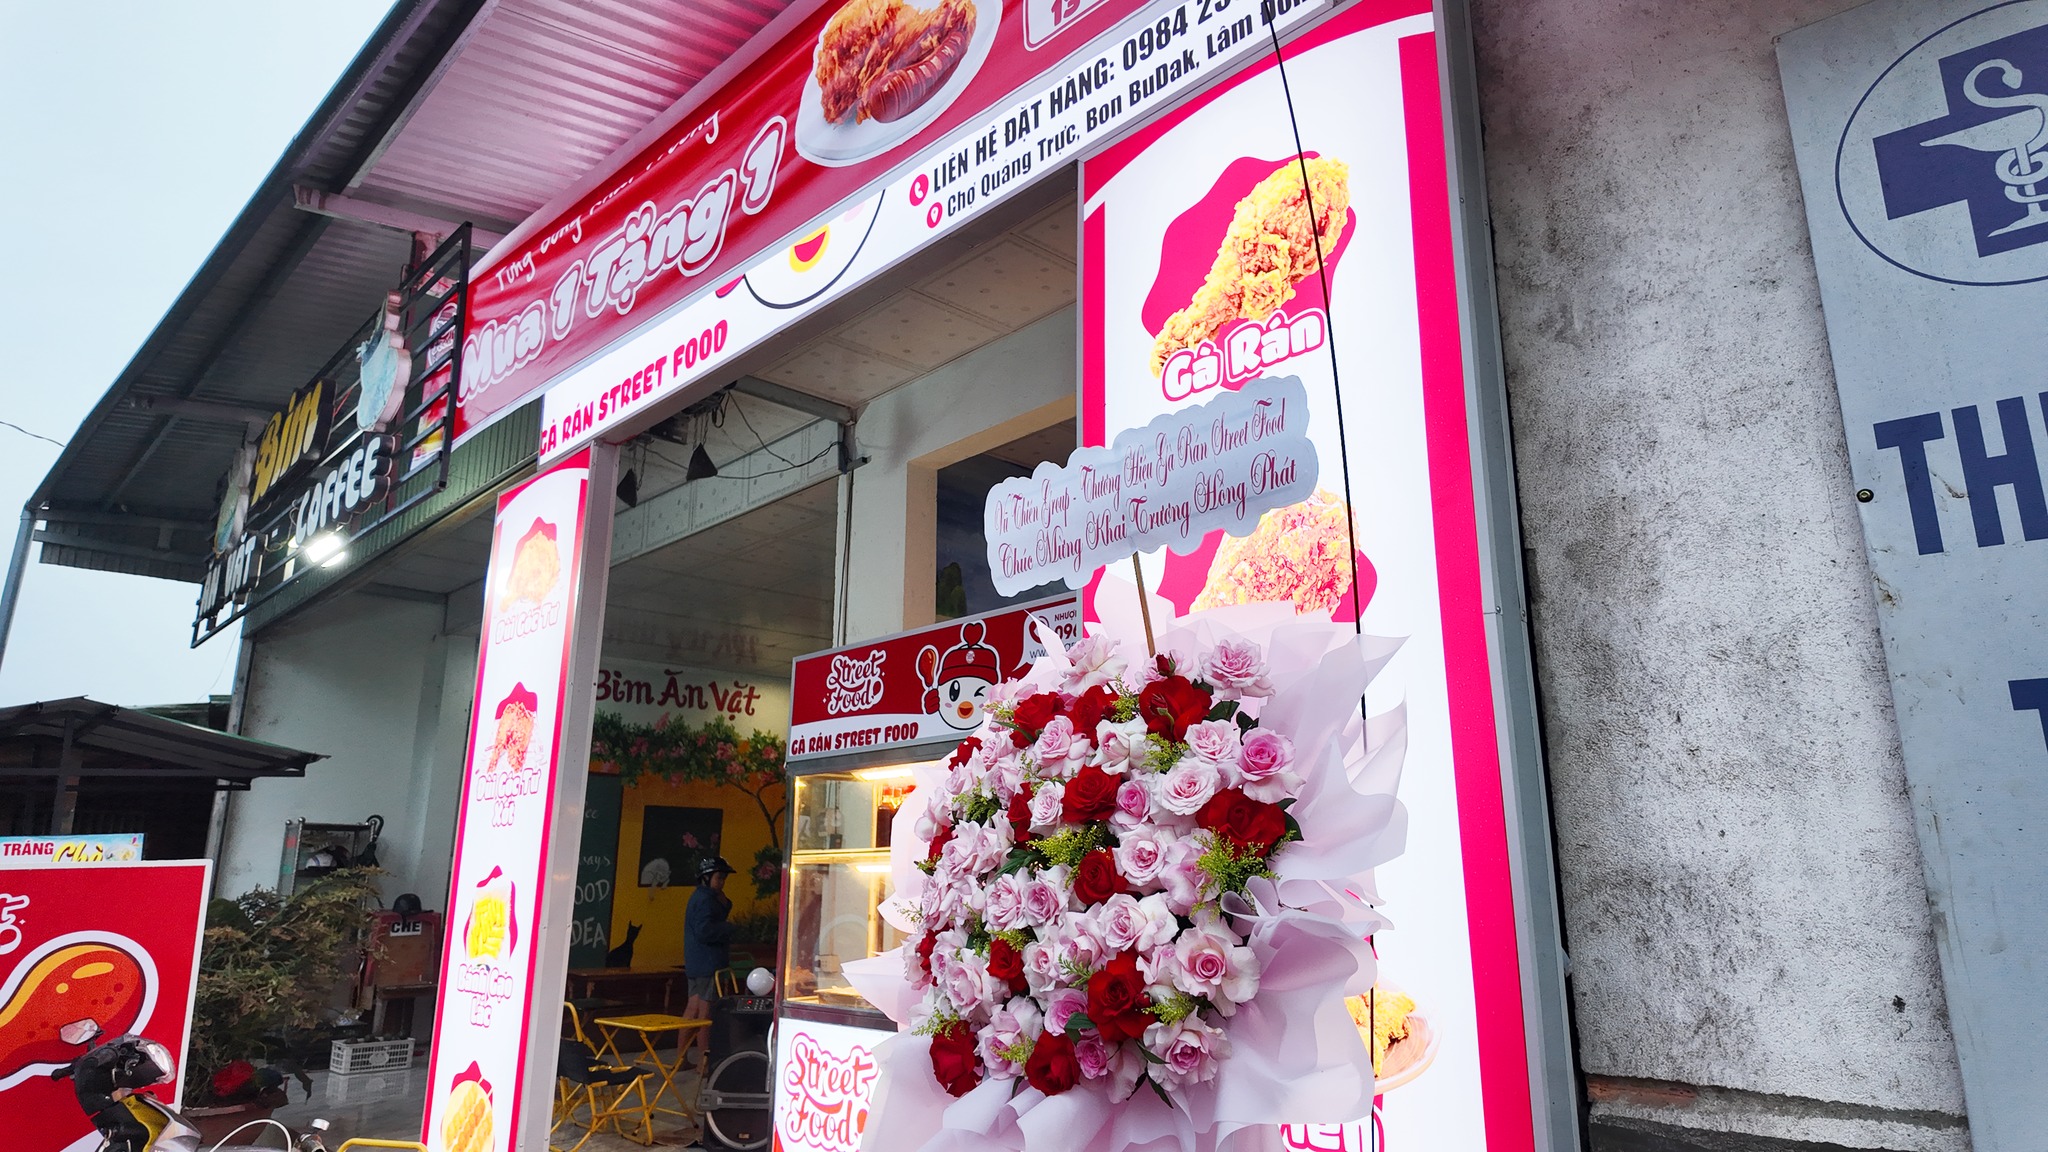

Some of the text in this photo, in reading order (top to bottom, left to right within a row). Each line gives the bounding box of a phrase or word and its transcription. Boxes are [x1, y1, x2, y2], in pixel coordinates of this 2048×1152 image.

[934, 148, 969, 194] LIÊN
[975, 125, 998, 168] HỆ
[1004, 100, 1042, 148] ĐẶT
[1049, 58, 1115, 119] HÀNG:
[1122, 5, 1188, 71] 0984
[947, 182, 975, 217] Chợ
[981, 151, 1031, 197] Quảng
[1086, 95, 1122, 133] Bon
[1206, 14, 1253, 60] Lâm
[457, 299, 547, 408] Mua
[550, 259, 584, 341] 1
[583, 200, 737, 317] Tặng
[739, 115, 787, 215] 1
[562, 401, 594, 443] RÁN
[598, 355, 667, 421] STREET
[672, 319, 728, 378] FOOD
[1163, 308, 1326, 401] Gà Rán
[1211, 412, 1249, 463] Street
[1251, 397, 1287, 442] Food
[295, 436, 381, 544] COFFEE
[999, 543, 1033, 578] Chúc
[1086, 509, 1127, 550] Khai
[1250, 449, 1298, 495] Phát
[1873, 394, 2048, 556] TH
[657, 668, 709, 709] Ăn
[708, 680, 761, 721] Vặt
[827, 650, 886, 687] Street
[828, 679, 874, 714] Food
[791, 722, 919, 755] GÀ RÁN STREET FOOD
[3, 840, 54, 857] TRÁNG
[786, 1040, 875, 1098] Street
[790, 1096, 855, 1147] Food
